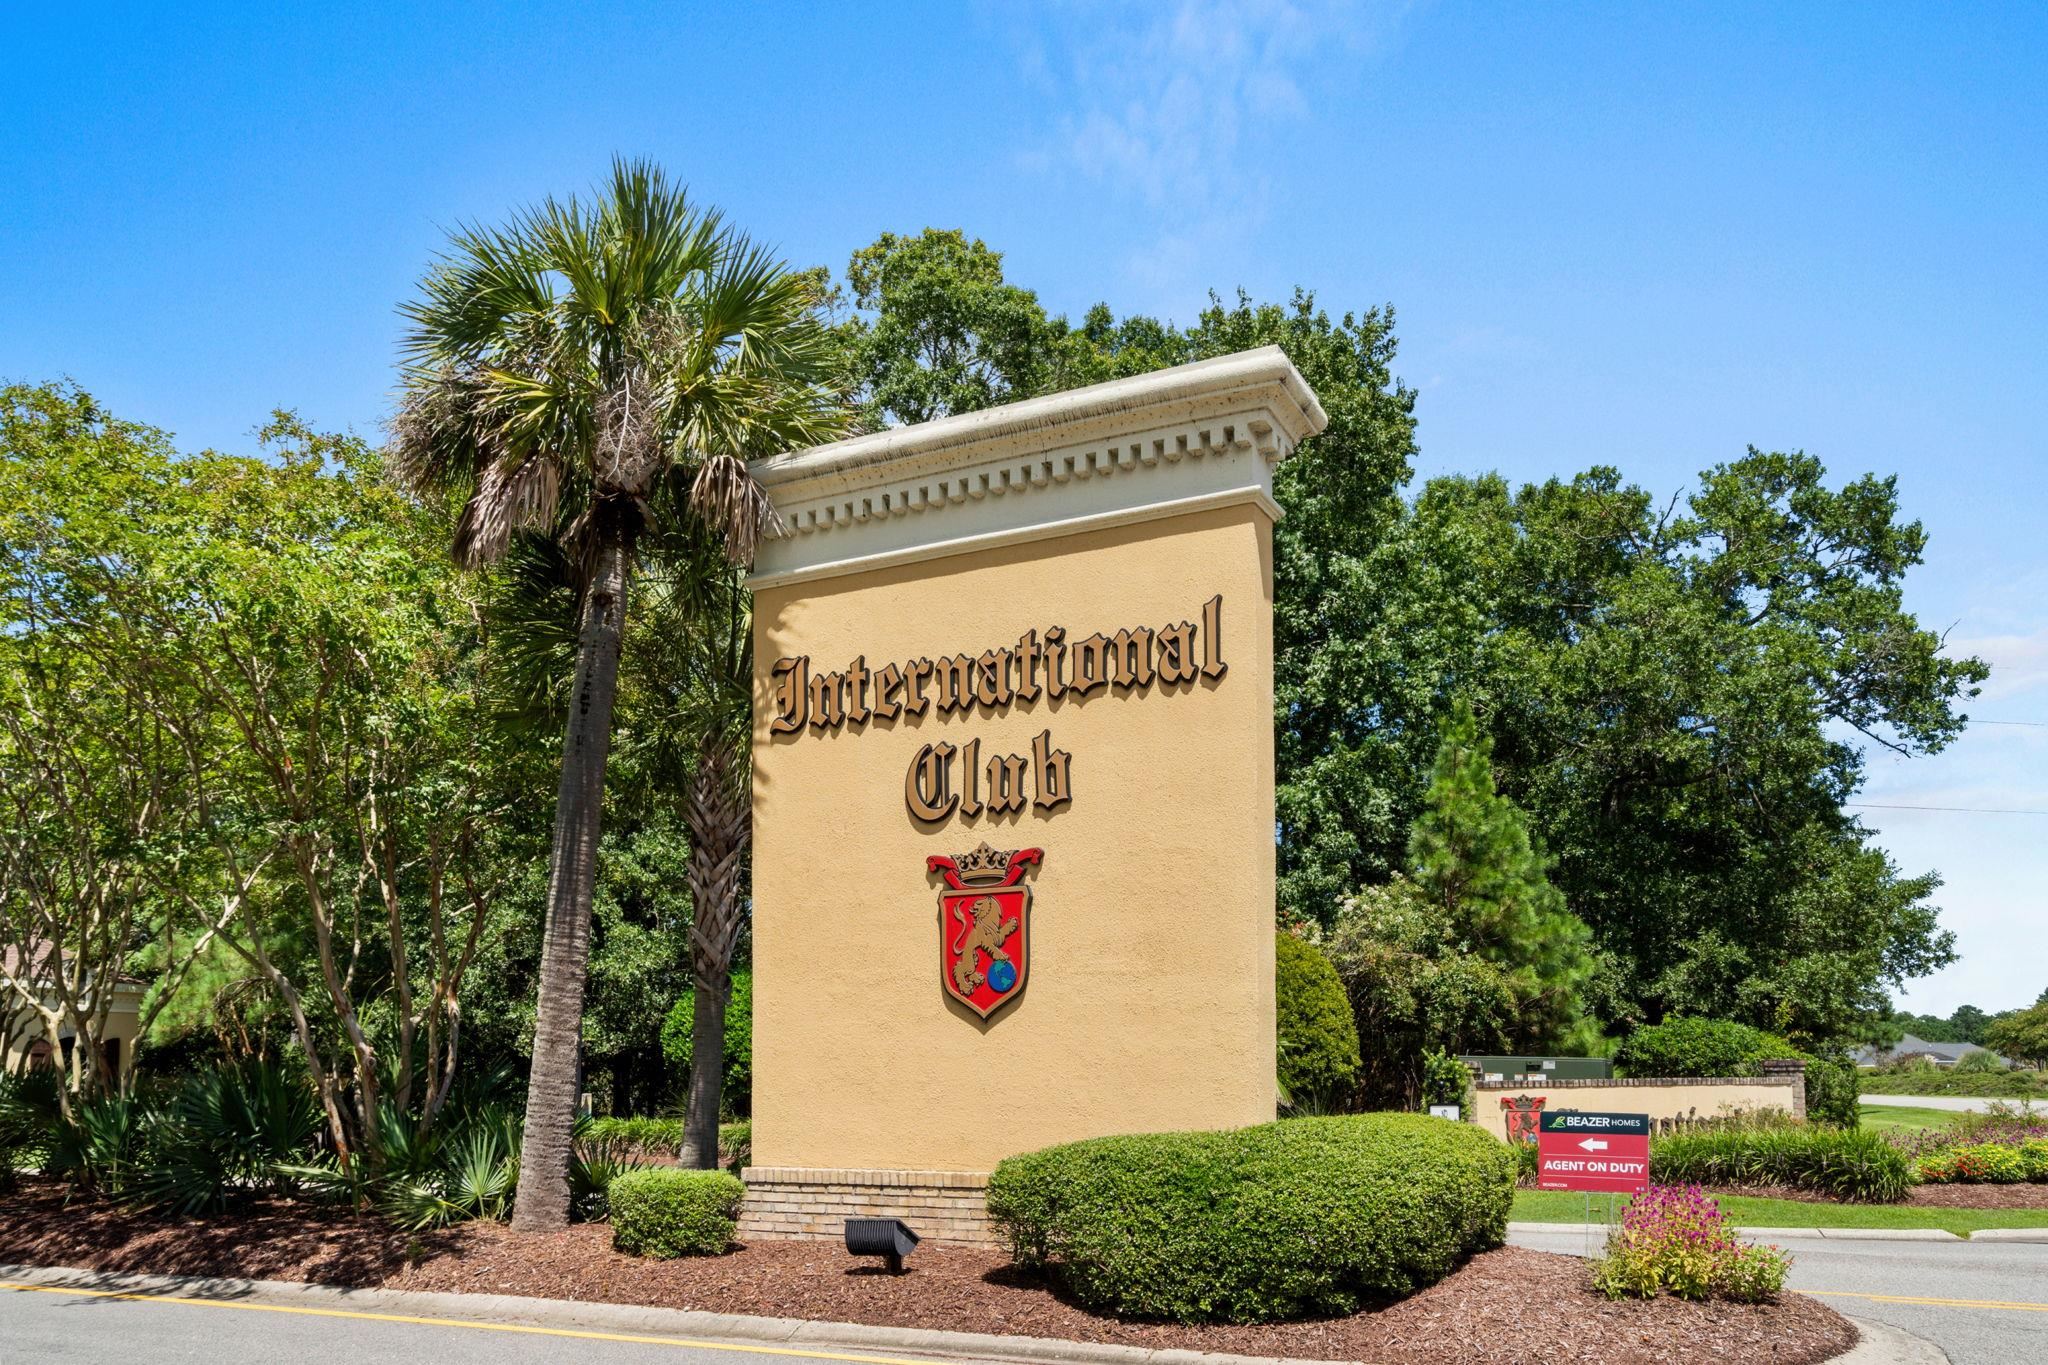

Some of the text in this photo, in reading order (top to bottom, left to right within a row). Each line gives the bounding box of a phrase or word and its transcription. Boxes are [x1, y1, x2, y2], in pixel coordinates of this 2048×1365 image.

[770, 594, 1228, 735] International
[905, 729, 1072, 823] Club
[1566, 1116, 1641, 1127] BEAZER HOMES
[1544, 1160, 1644, 1173] AGENT ON DUTY
